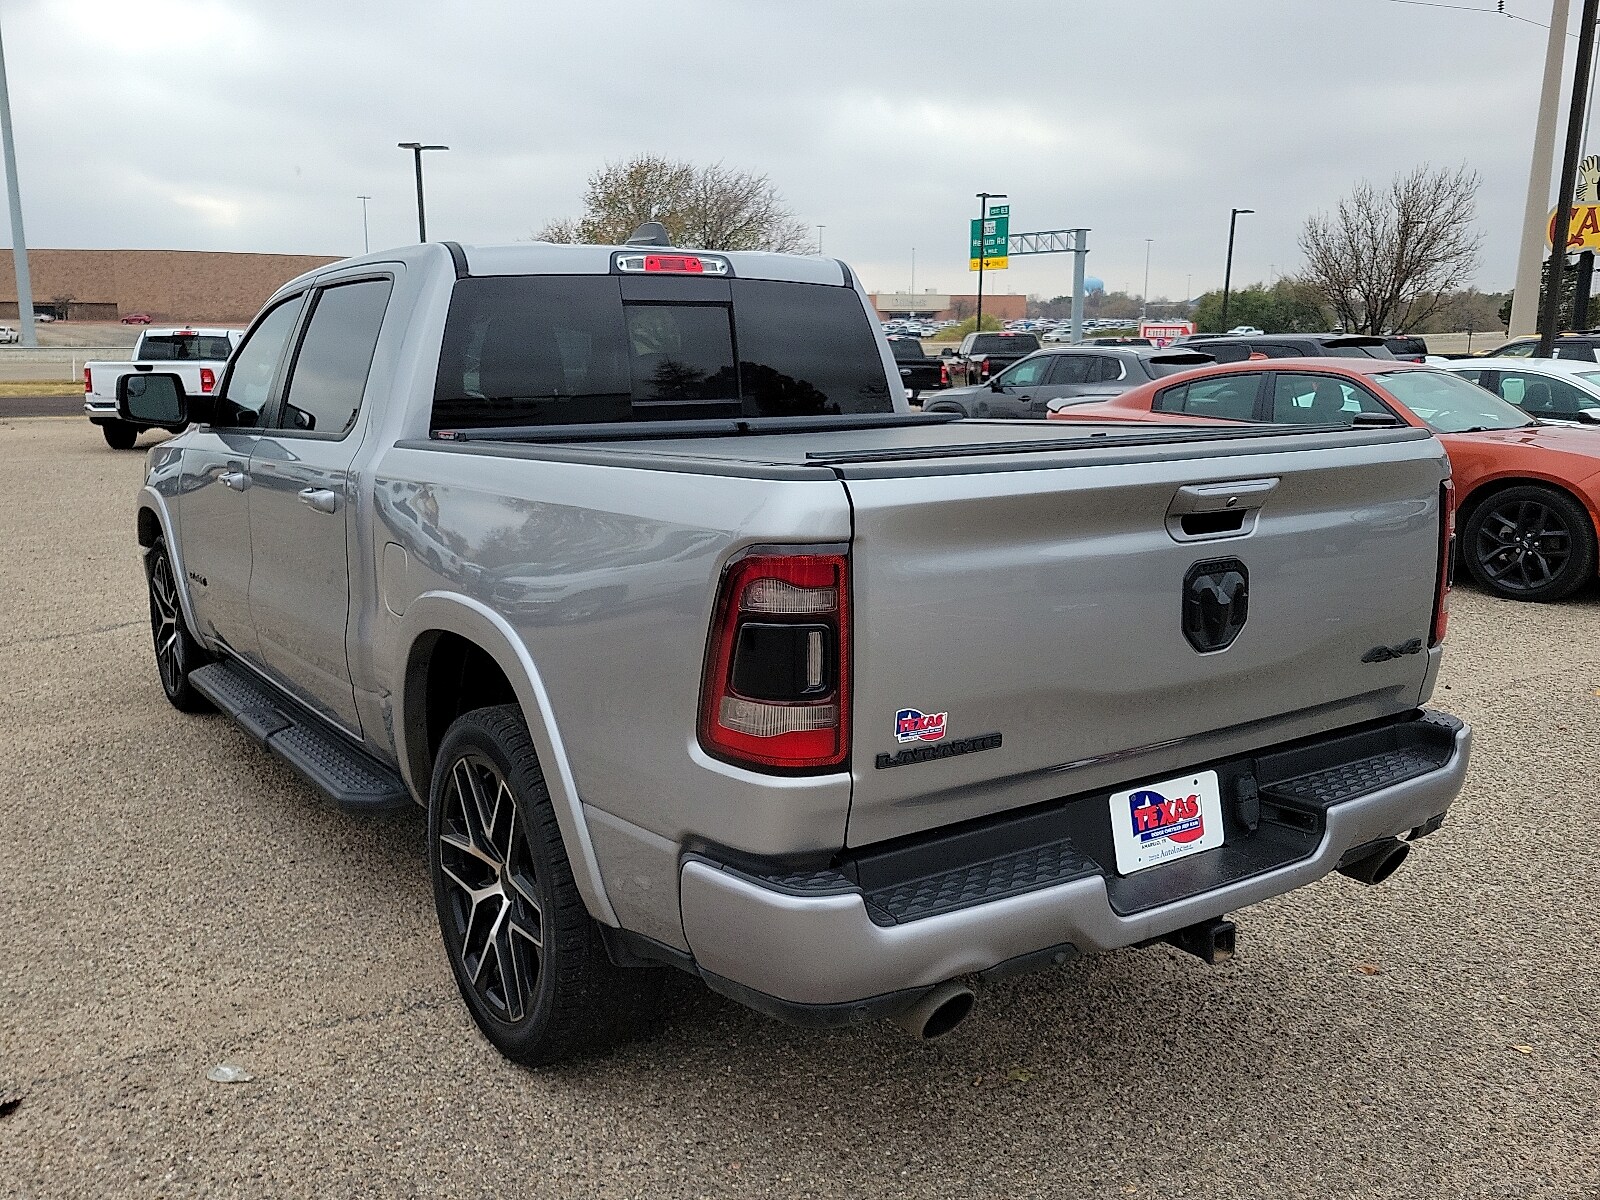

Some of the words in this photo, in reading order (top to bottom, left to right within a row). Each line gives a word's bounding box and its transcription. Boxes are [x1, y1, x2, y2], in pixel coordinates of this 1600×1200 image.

[997, 236, 1006, 245] Rd
[898, 713, 944, 732] TEXAS
[875, 733, 1002, 769] LARAMIE
[1134, 795, 1199, 831] TEXAS
